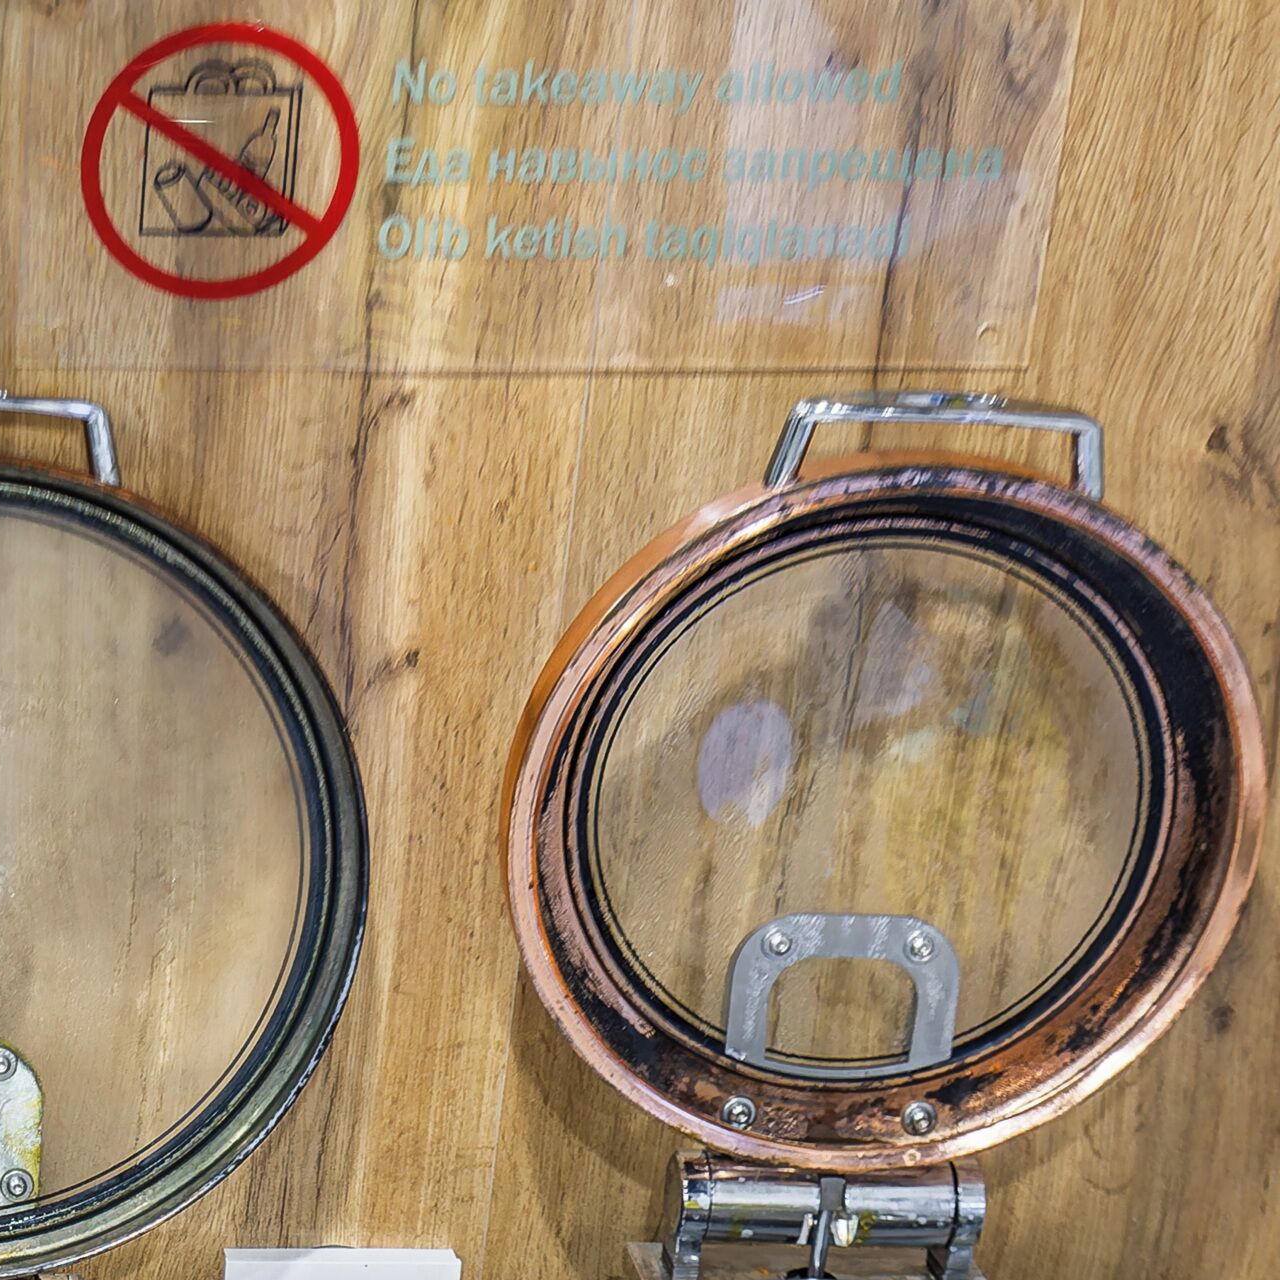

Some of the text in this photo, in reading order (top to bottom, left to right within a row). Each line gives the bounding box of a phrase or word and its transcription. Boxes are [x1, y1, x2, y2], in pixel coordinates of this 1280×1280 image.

[393, 56, 905, 117] No takeaway allowed
[385, 136, 1004, 192] Еда навынос запрещена
[378, 212, 912, 269] Olib ketish taqiqlanadi
